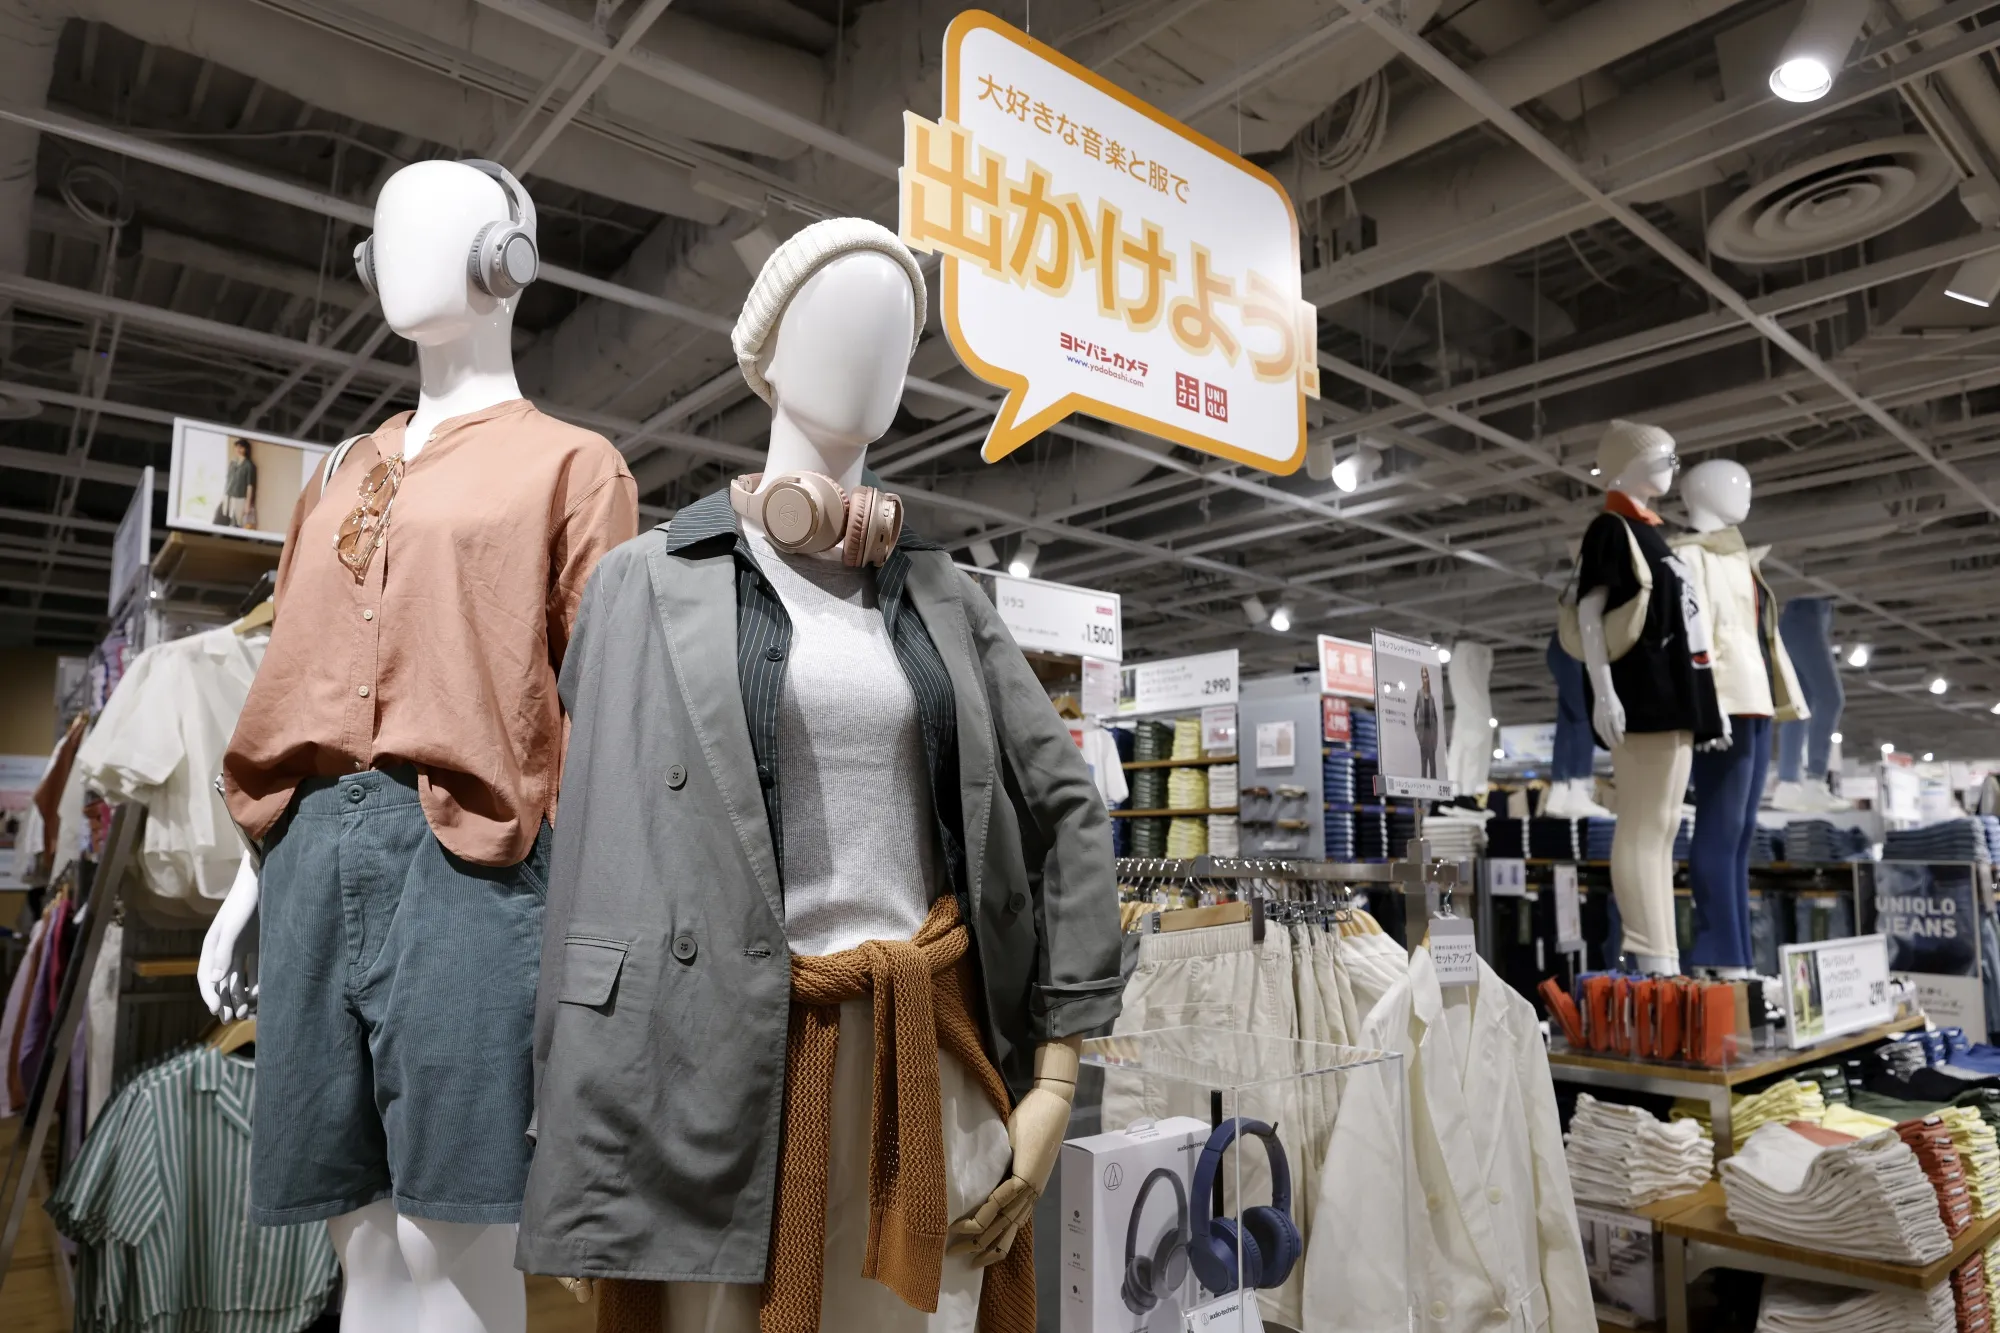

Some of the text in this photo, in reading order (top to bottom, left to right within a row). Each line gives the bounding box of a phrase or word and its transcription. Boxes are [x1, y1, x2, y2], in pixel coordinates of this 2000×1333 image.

[977, 74, 1191, 205] 大好きな音楽と服で
[1060, 332, 1149, 377] ヨドバシカメラ
[1066, 355, 1145, 388] www.yodobashi.com
[1875, 896, 1956, 917] UNIQLO
[1877, 917, 1957, 939] JEANS
[1435, 952, 1472, 965] セットアップ
